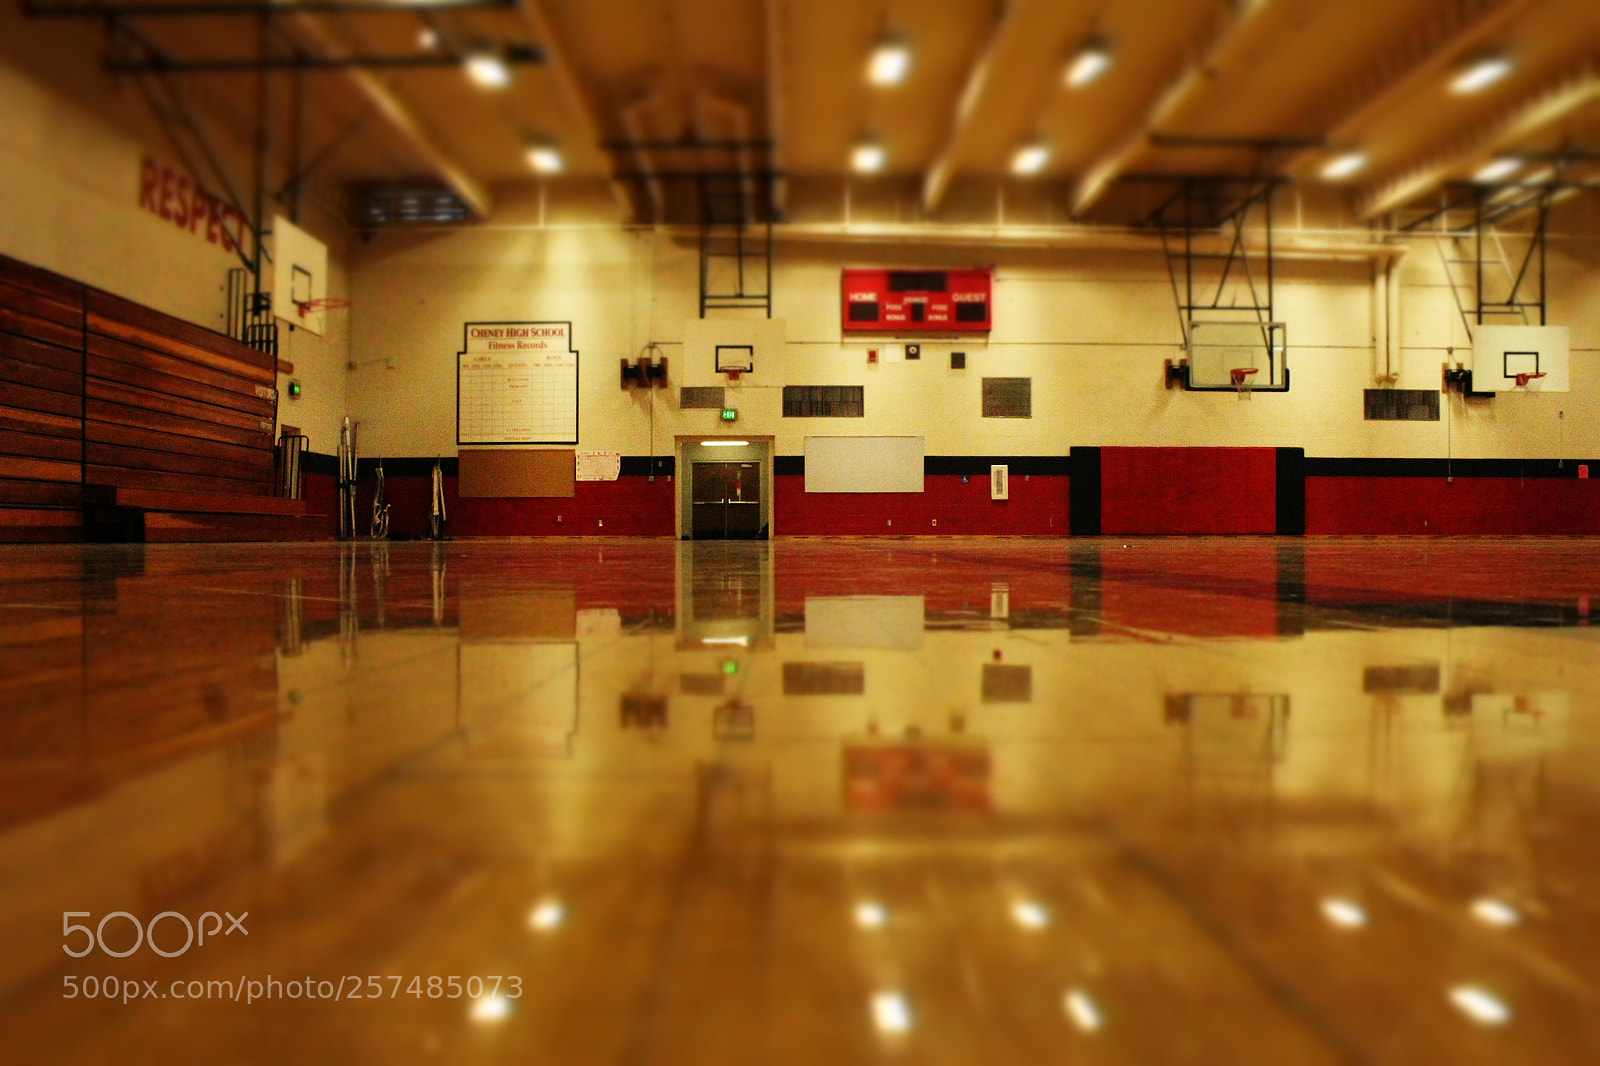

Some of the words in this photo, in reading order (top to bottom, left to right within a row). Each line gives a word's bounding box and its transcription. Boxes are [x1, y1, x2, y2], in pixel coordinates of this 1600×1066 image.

[139, 157, 245, 253] RESPECT
[850, 293, 877, 301] HOME
[952, 293, 986, 302] GUEST
[471, 328, 504, 338] CHENEY
[506, 328, 529, 337] HIGH
[531, 328, 565, 337] SCHOOL
[488, 341, 515, 350] Fitness
[517, 341, 547, 349] Records
